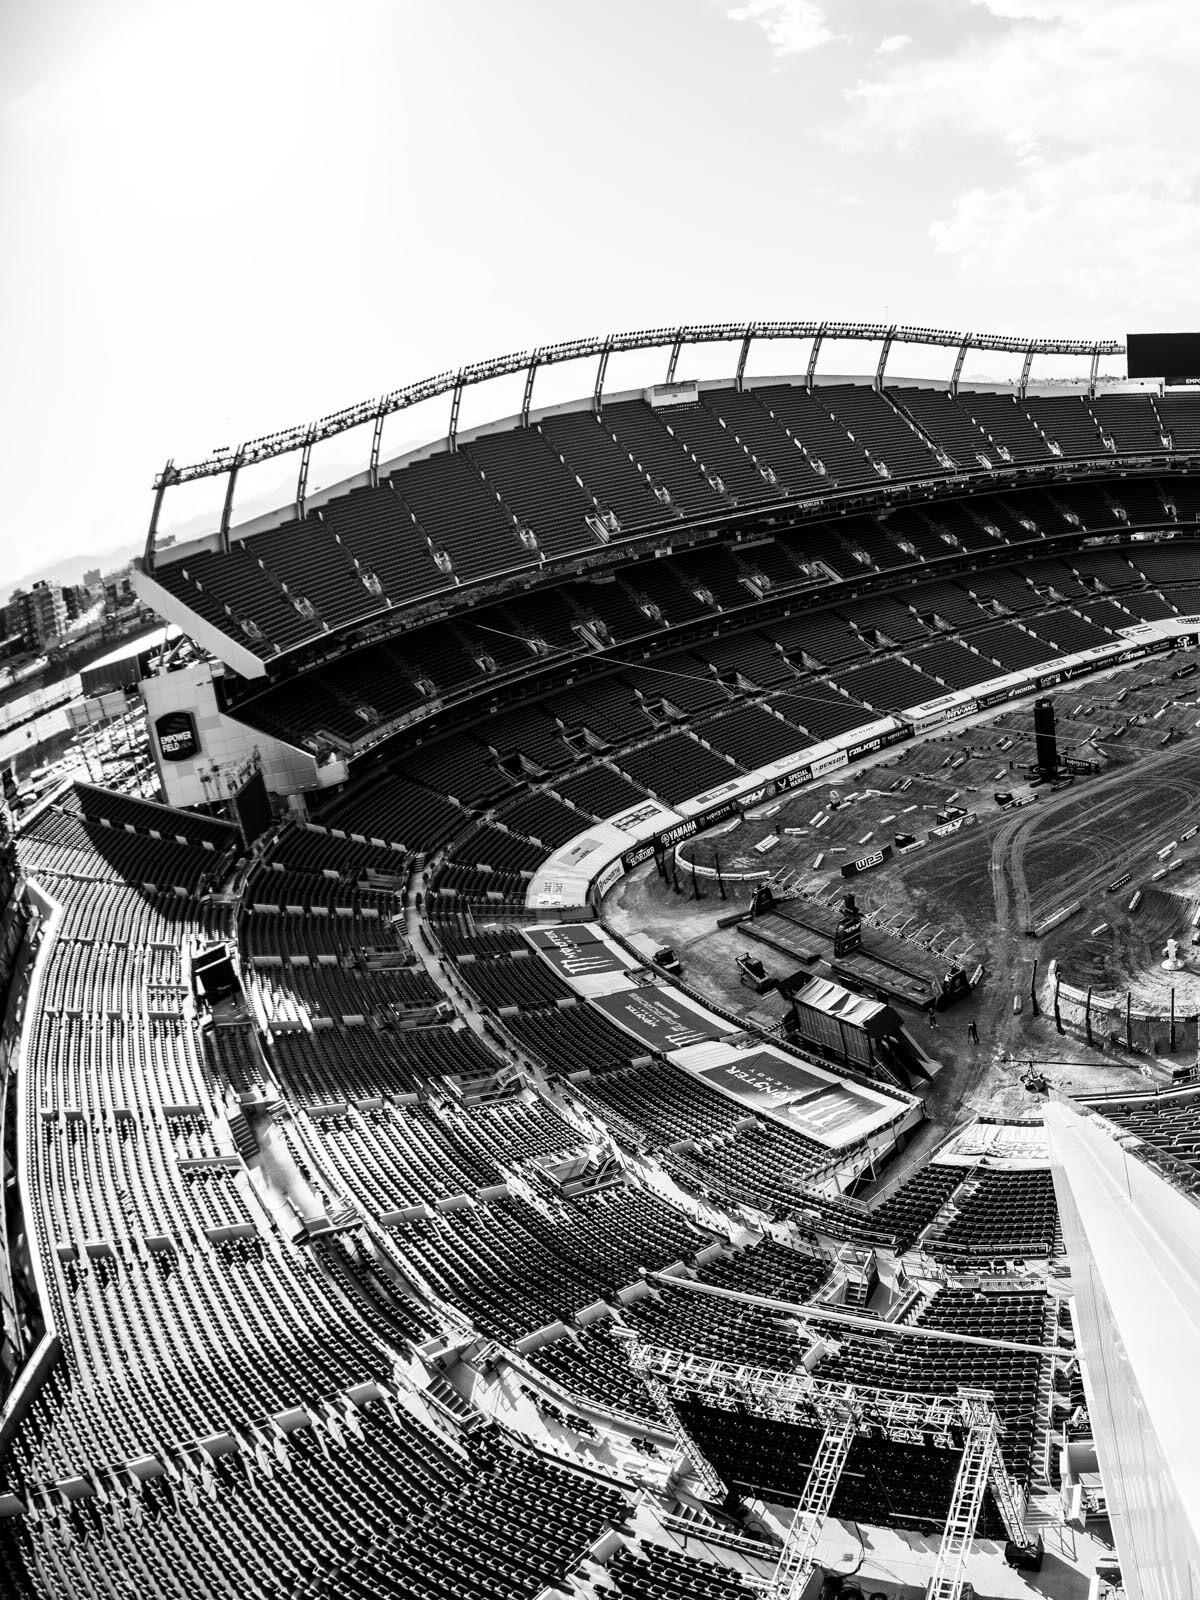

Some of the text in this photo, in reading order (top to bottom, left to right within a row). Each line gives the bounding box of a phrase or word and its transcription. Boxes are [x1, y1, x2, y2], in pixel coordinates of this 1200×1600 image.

[1041, 673, 1061, 684] GoPro
[1014, 684, 1036, 697] HONDA
[160, 731, 192, 745] EMPOWER
[162, 742, 180, 753] FIELD
[849, 738, 881, 757] FALKEN
[818, 754, 846, 771] DUNLOP
[788, 769, 809, 782] SPECIAL
[790, 773, 813, 787] WARFARE
[706, 806, 731, 821] MONSTER
[668, 820, 697, 840] YAMAHA
[855, 850, 884, 871] WPS
[543, 930, 578, 959] MONSTER
[624, 1004, 660, 1027] MONSTER
